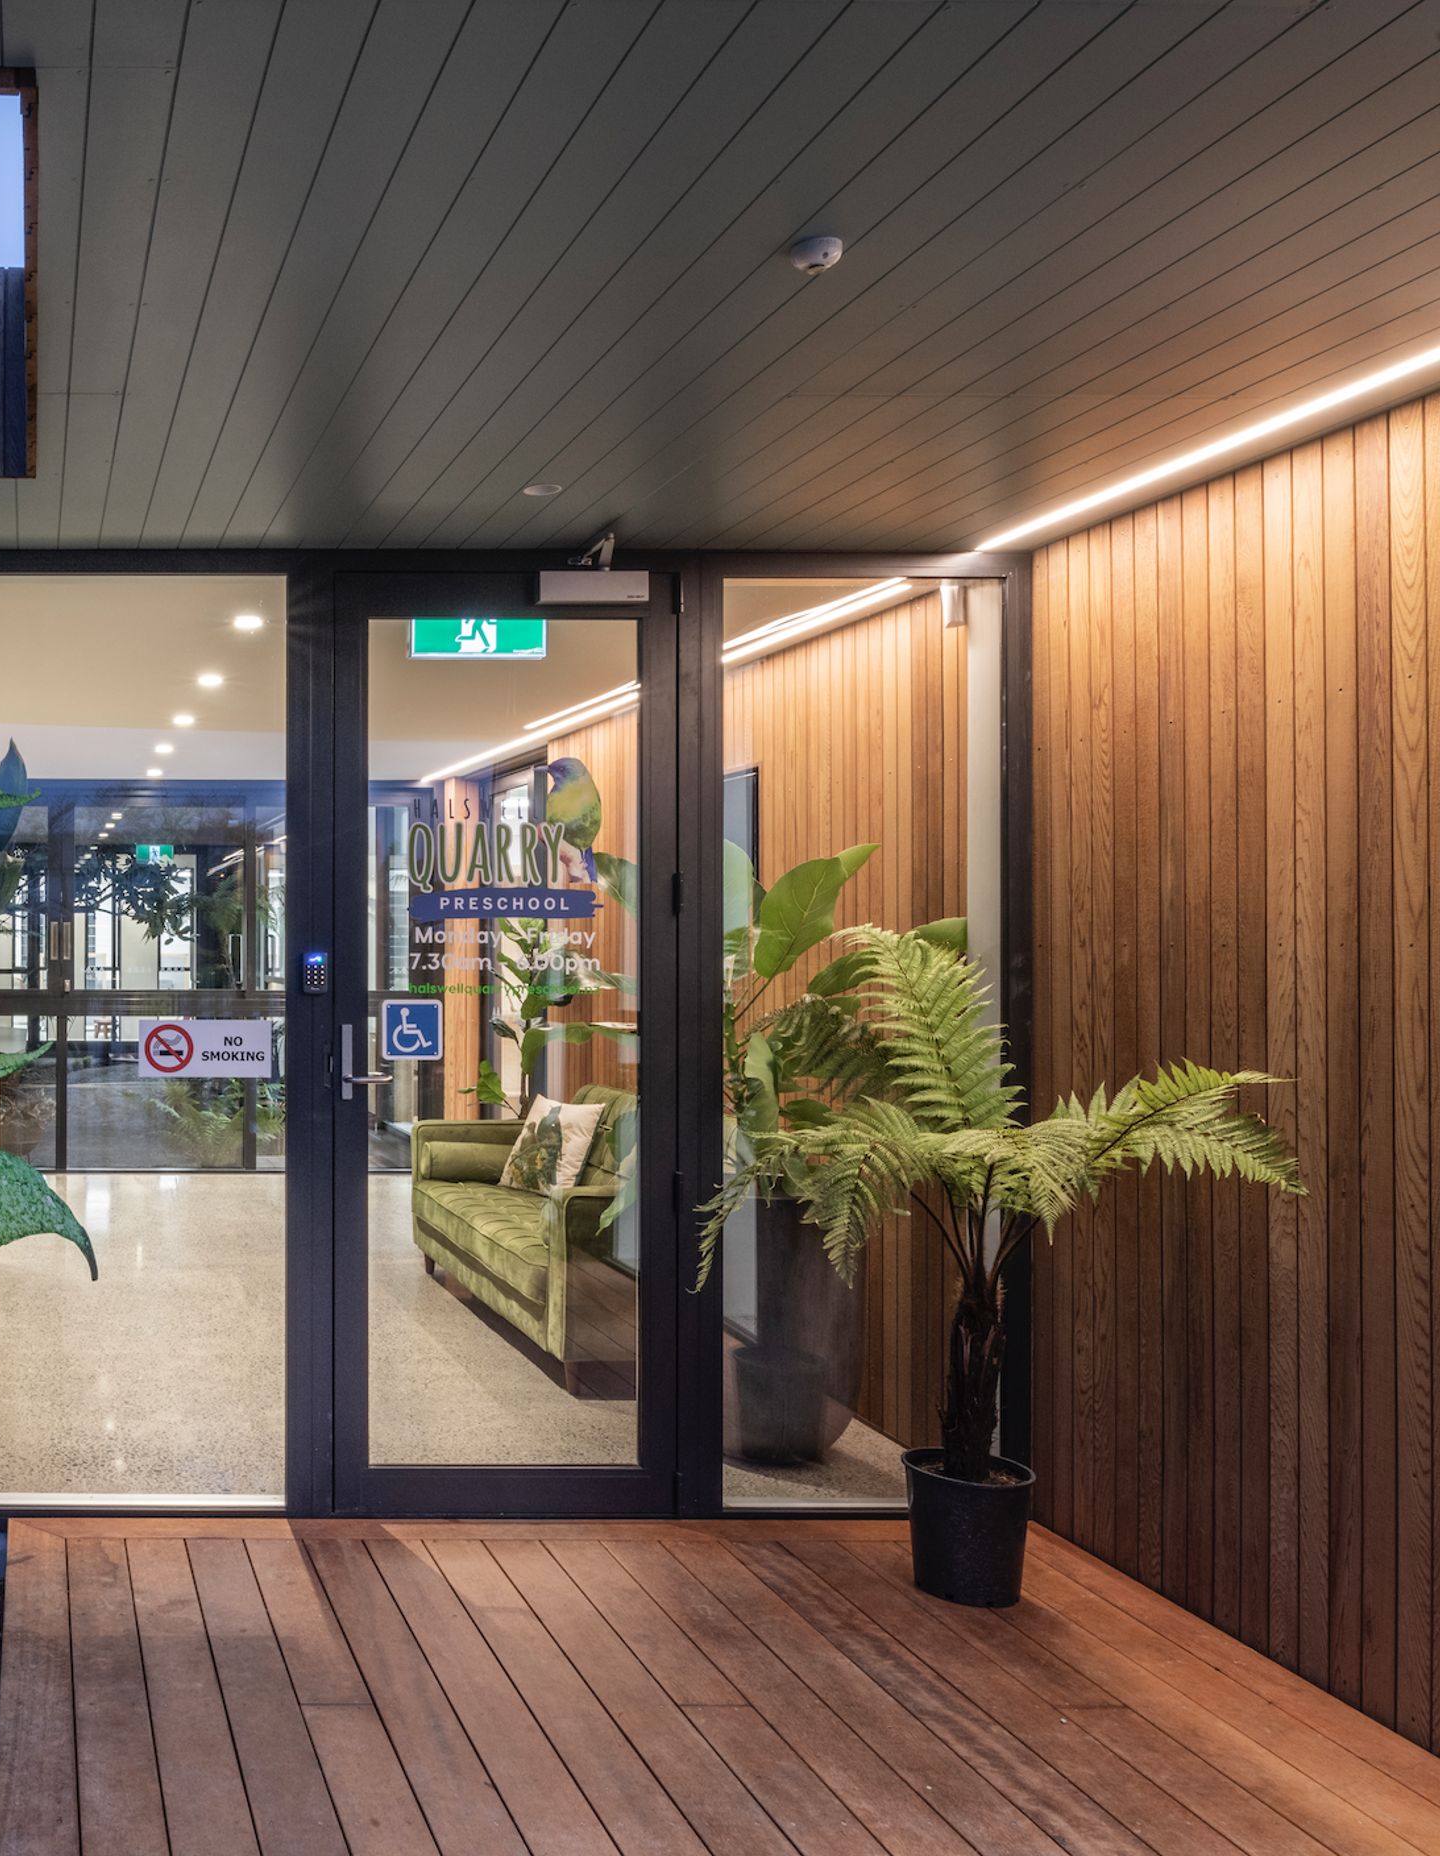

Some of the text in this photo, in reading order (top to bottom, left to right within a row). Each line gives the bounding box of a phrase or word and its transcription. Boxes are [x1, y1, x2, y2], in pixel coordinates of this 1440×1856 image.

[409, 821, 564, 893] QUARRY
[440, 897, 569, 910] PRESCHOOL
[414, 926, 596, 948] Monday Friday
[410, 952, 492, 970] 7.30am
[410, 982, 600, 997] halswellquarypreschool.nz
[223, 1036, 243, 1047] NO
[201, 1050, 265, 1062] SMOKING
